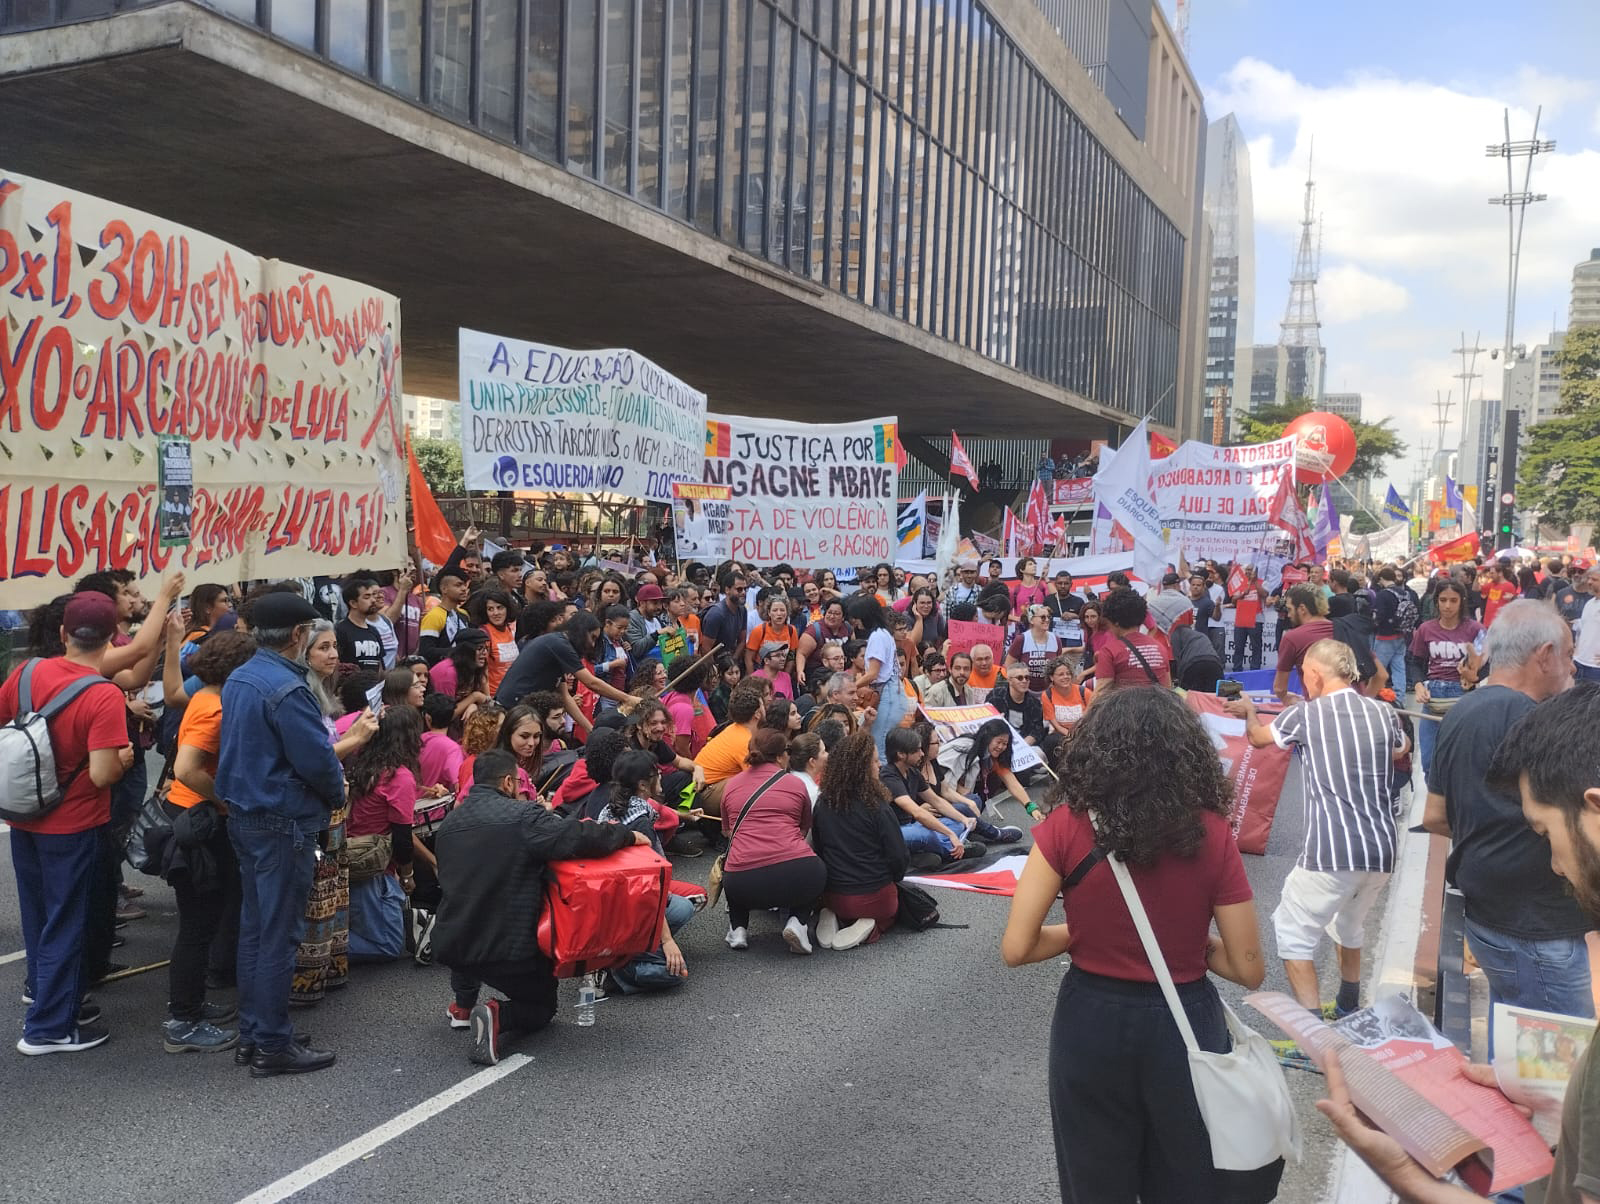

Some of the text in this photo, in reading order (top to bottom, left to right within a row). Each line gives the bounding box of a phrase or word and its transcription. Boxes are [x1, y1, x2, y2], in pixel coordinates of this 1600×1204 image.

[88, 219, 190, 327] 30H
[187, 250, 241, 345] SEM
[240, 272, 335, 355] REDUÇÃO
[488, 341, 510, 377] A
[524, 350, 634, 386] EDUCAÇÃO
[80, 335, 267, 452] ARCABOUÇO
[269, 396, 291, 423] DE
[290, 379, 349, 444] LULA
[470, 379, 515, 414] UNIR
[515, 381, 600, 416] PROFESSORES
[472, 415, 555, 455] DERROTAR
[634, 434, 660, 467] NEM
[736, 433, 837, 467] JUSTIÇA
[843, 437, 874, 461] POR
[523, 463, 594, 488] ESQUERDA
[703, 459, 892, 498] NGAGNE MBAYE
[264, 484, 350, 557] LUTAS
[349, 487, 384, 556] JÁ!
[773, 509, 796, 530] DE
[802, 502, 888, 530] VIOLÊNCIA
[731, 537, 815, 560] POLICIAL
[833, 535, 889, 559] RACISMO
